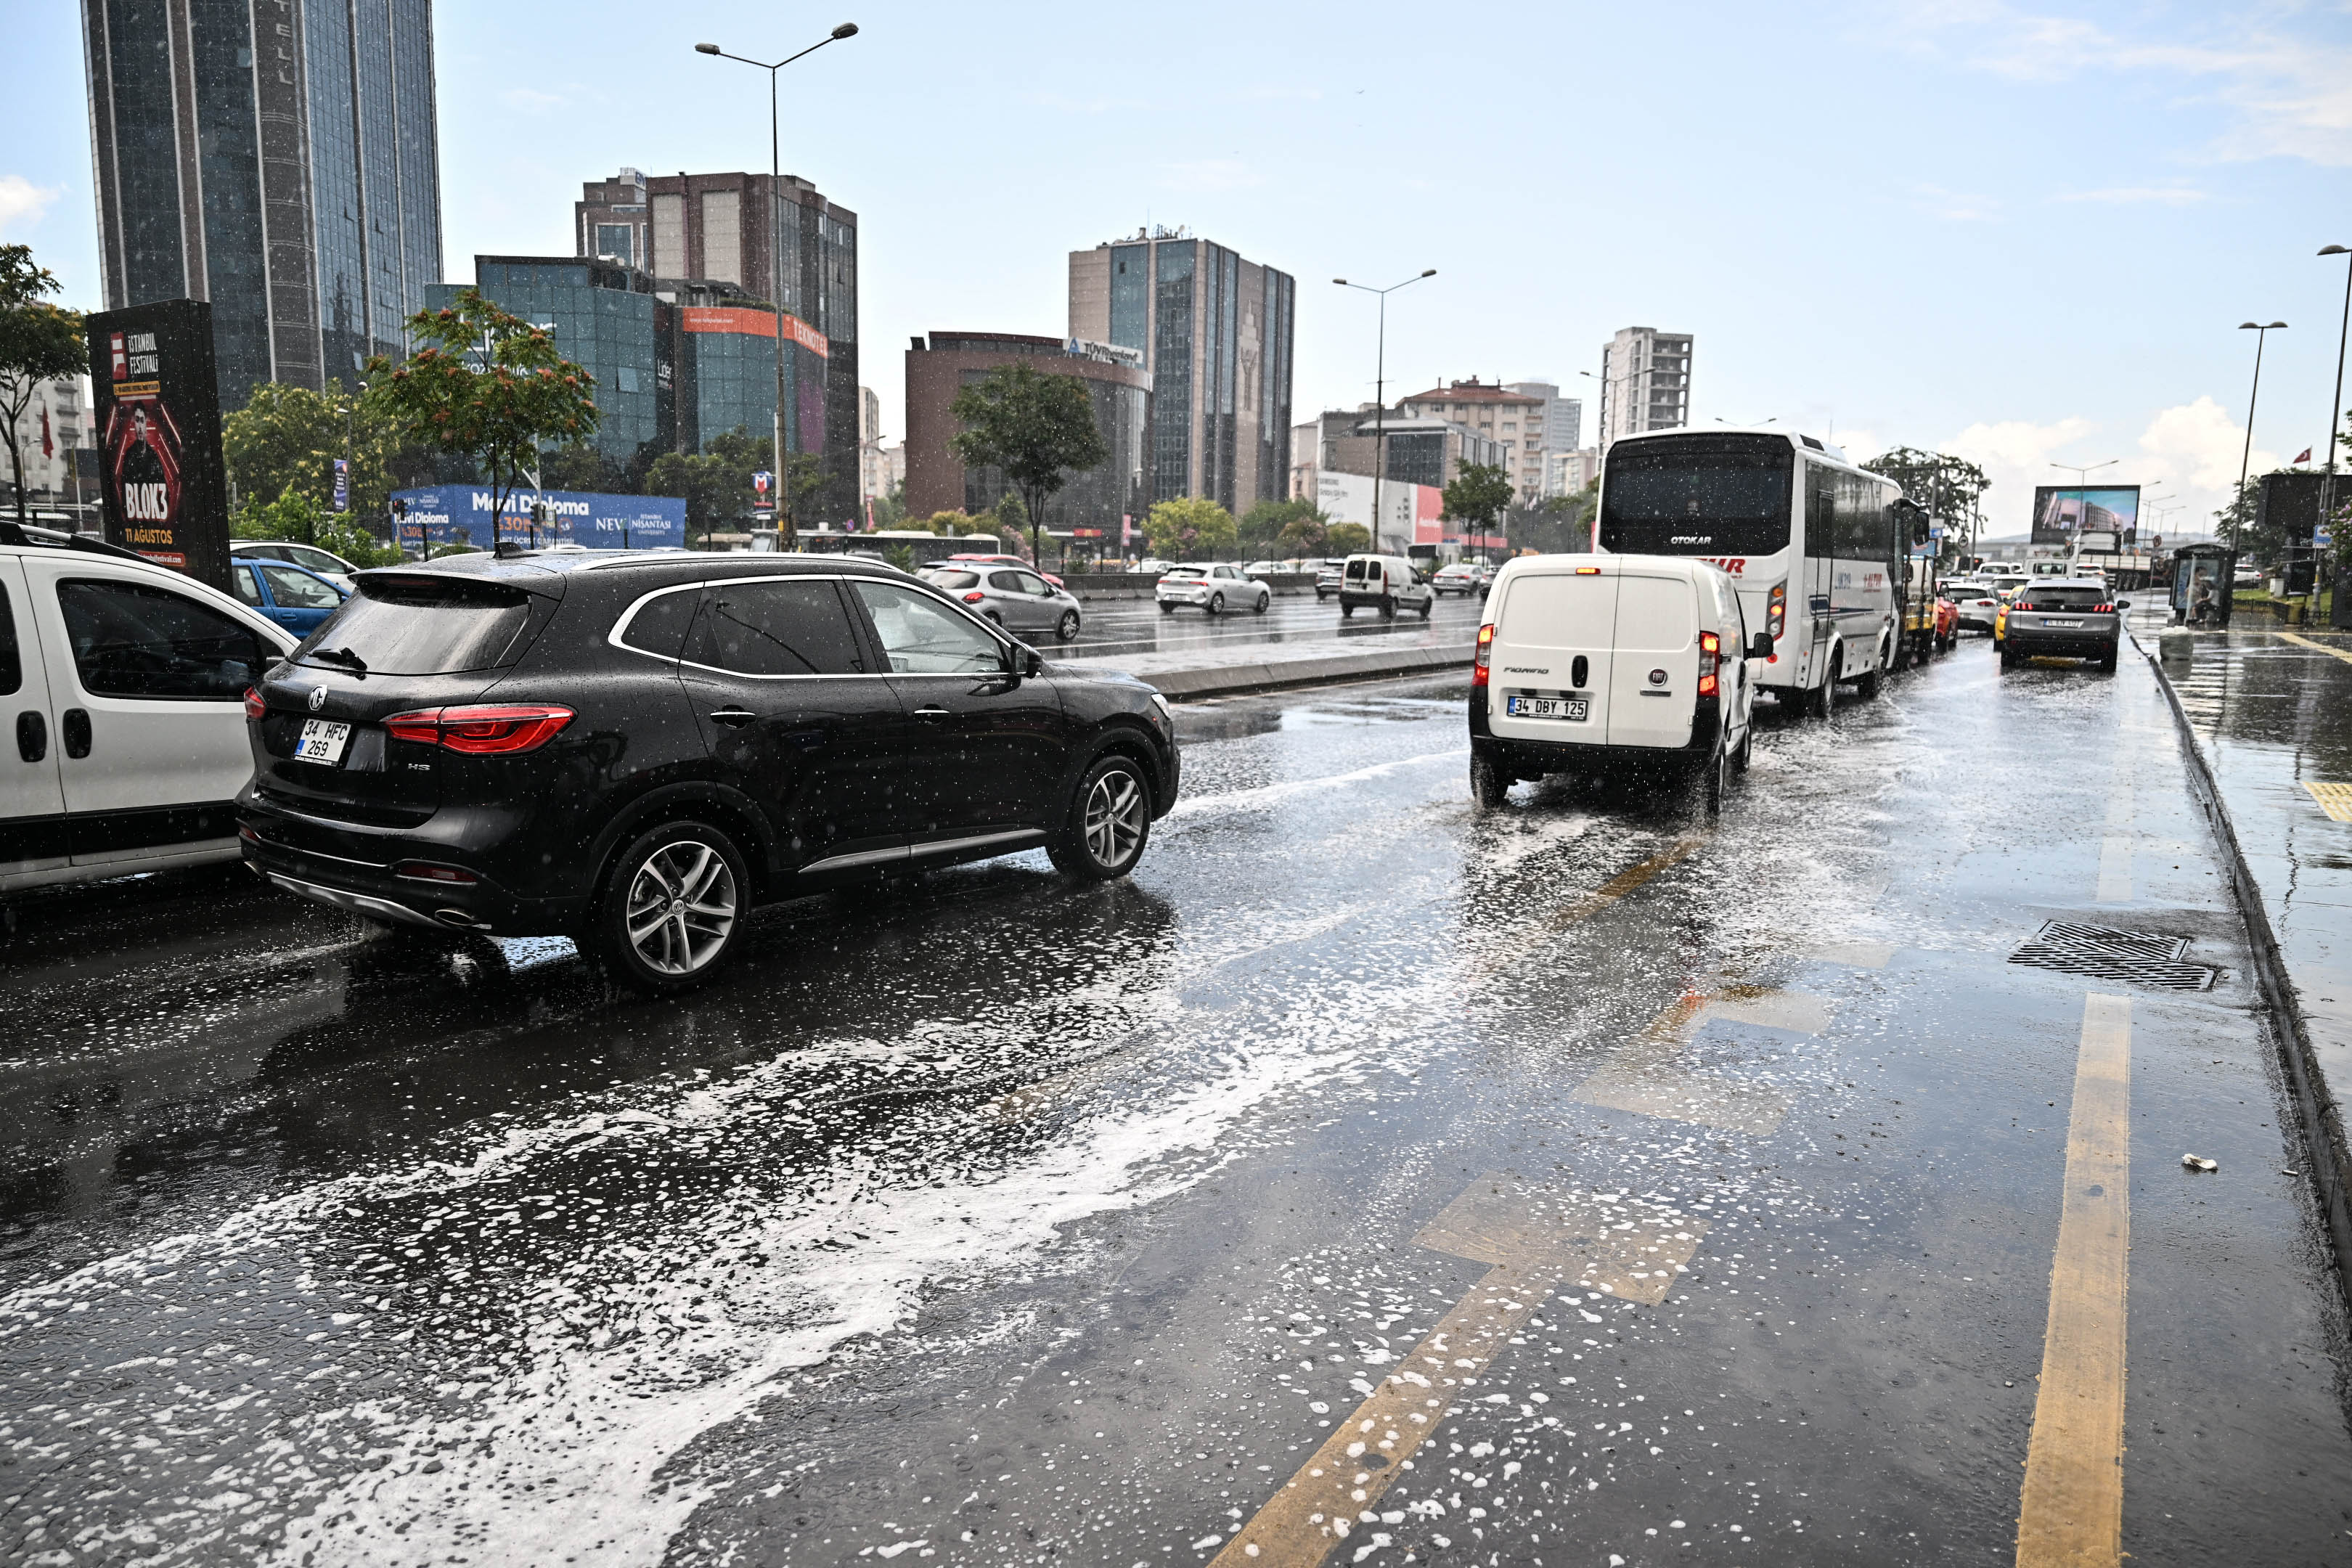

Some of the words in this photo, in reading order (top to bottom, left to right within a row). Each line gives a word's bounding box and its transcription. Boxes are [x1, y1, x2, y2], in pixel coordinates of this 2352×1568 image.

[793, 320, 828, 356] TEKNOTEL
[125, 483, 168, 520] BLOK3
[415, 511, 449, 523] Diploma
[134, 525, 173, 544] AĞUSTOS
[1515, 699, 1530, 712] 34
[1535, 700, 1557, 714] DBY
[1564, 702, 1584, 715] 125
[305, 720, 319, 736] 34
[324, 723, 347, 741] HFC
[307, 740, 329, 756] 269
